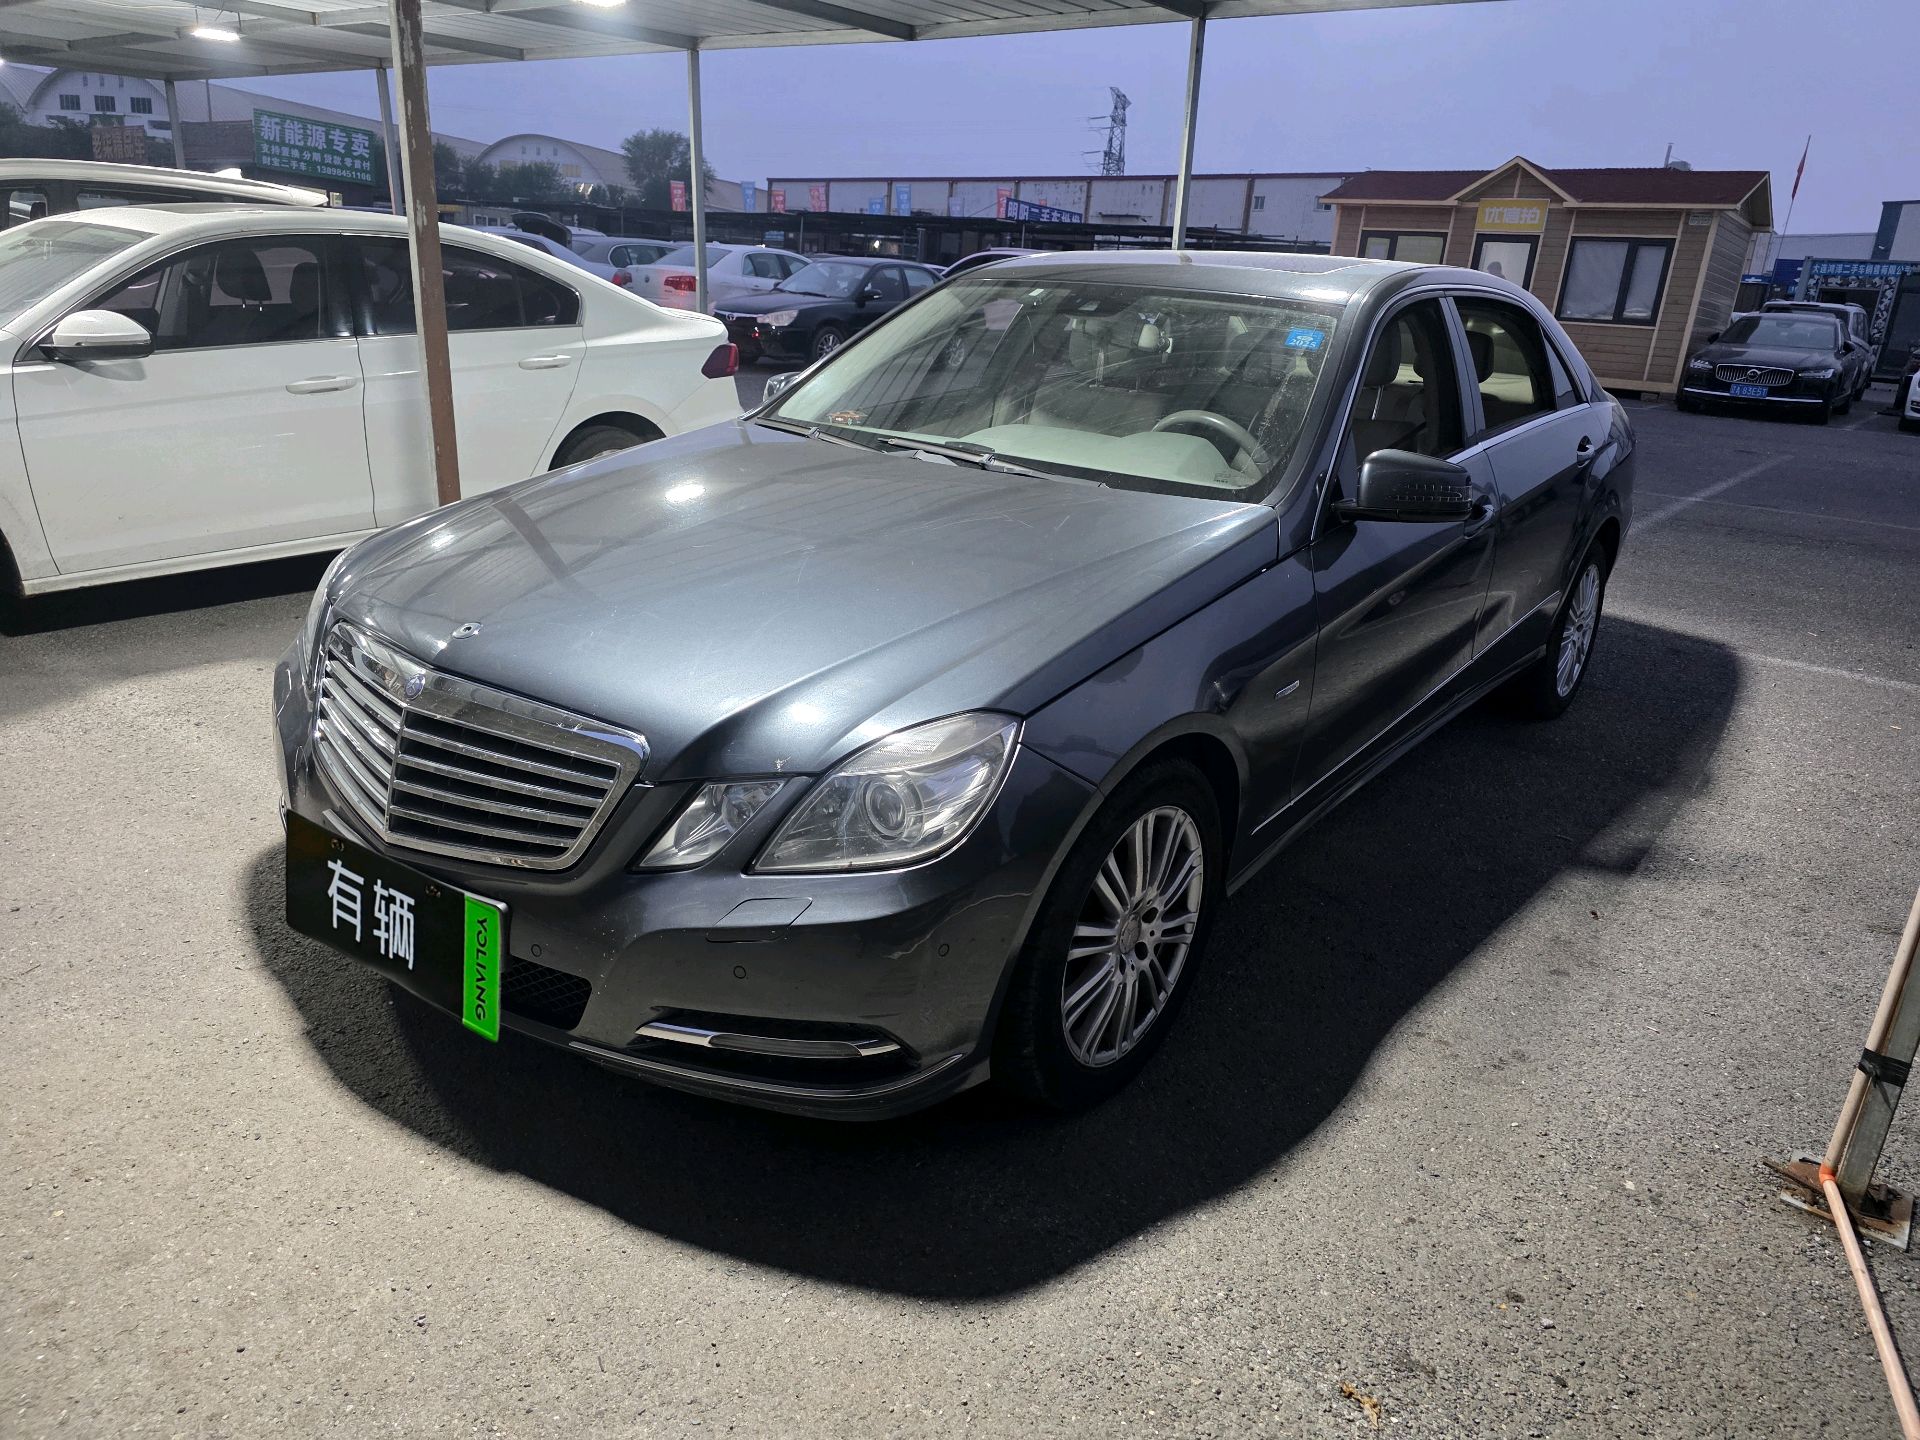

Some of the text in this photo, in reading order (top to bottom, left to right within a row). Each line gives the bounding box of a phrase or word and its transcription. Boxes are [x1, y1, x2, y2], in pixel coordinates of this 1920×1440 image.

[261, 115, 370, 158] 新能源专卖
[261, 143, 300, 159] 支持置换
[344, 157, 370, 171] 零首付
[327, 859, 415, 970] 有辆
[475, 917, 488, 1021] YOLIANG
